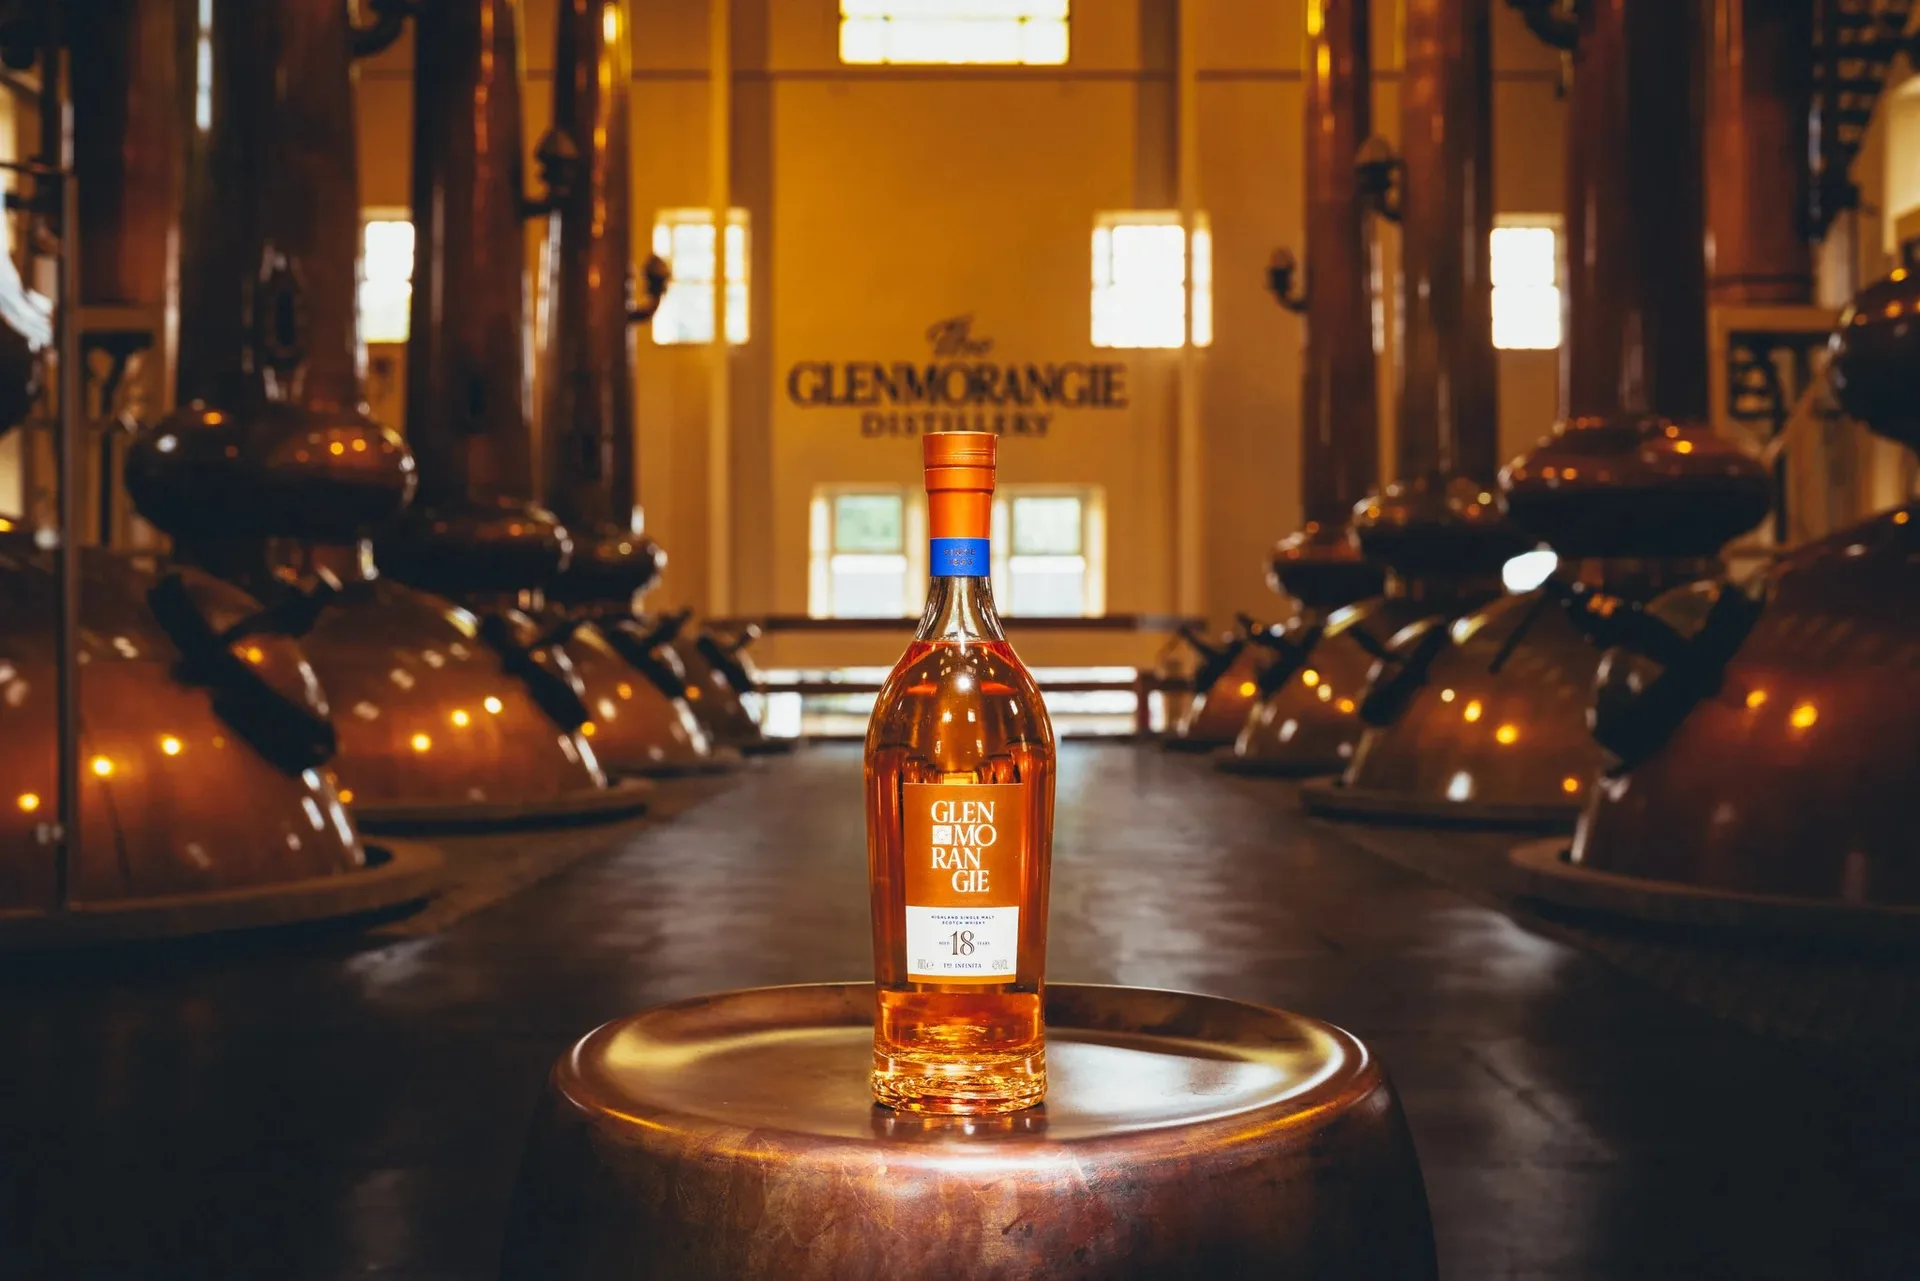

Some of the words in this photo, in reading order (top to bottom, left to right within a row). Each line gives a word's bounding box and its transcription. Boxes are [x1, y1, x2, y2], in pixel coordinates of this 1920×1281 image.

[787, 361, 1128, 408] GLENMORANGIE
[861, 411, 1052, 438] DISTILLERY
[930, 800, 996, 824] GLEN
[952, 823, 997, 847] MO
[931, 847, 982, 870] RAN
[951, 869, 990, 893] GIE
[950, 930, 975, 956] 18
